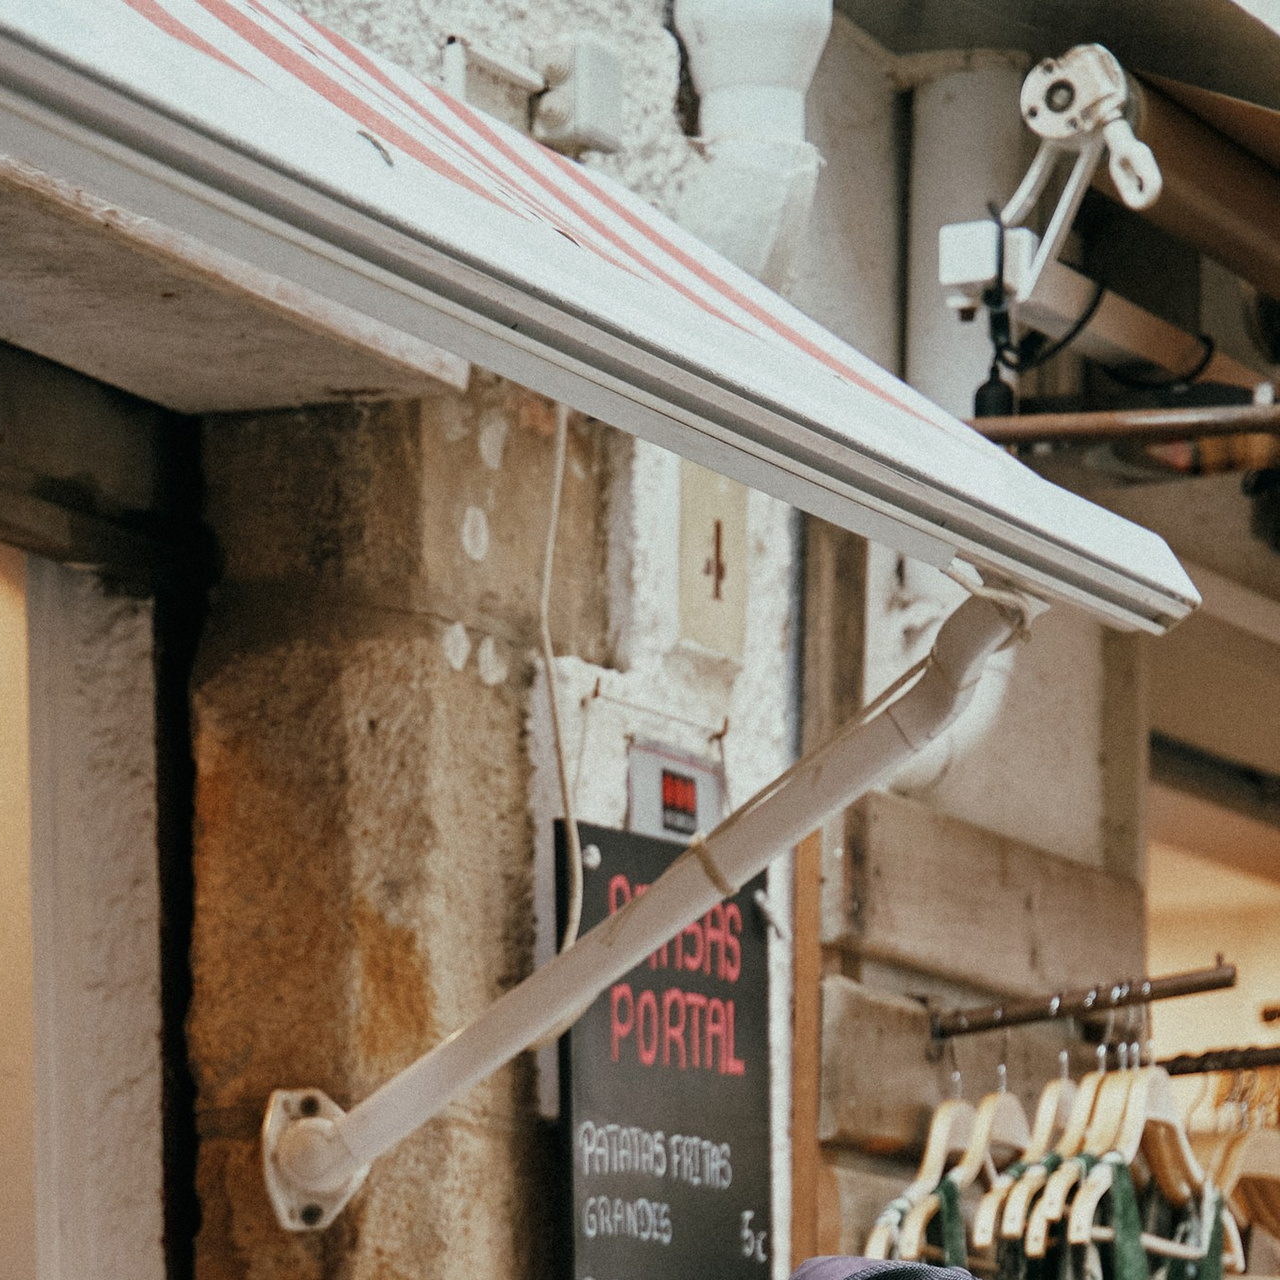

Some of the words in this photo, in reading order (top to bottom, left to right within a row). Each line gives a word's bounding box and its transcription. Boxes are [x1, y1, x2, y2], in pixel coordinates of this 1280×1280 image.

[610, 983, 745, 1076] PORTAL
[579, 1120, 667, 1177] PATATAS
[669, 1133, 733, 1190] FRITAS
[583, 1195, 673, 1245] GRANDES
